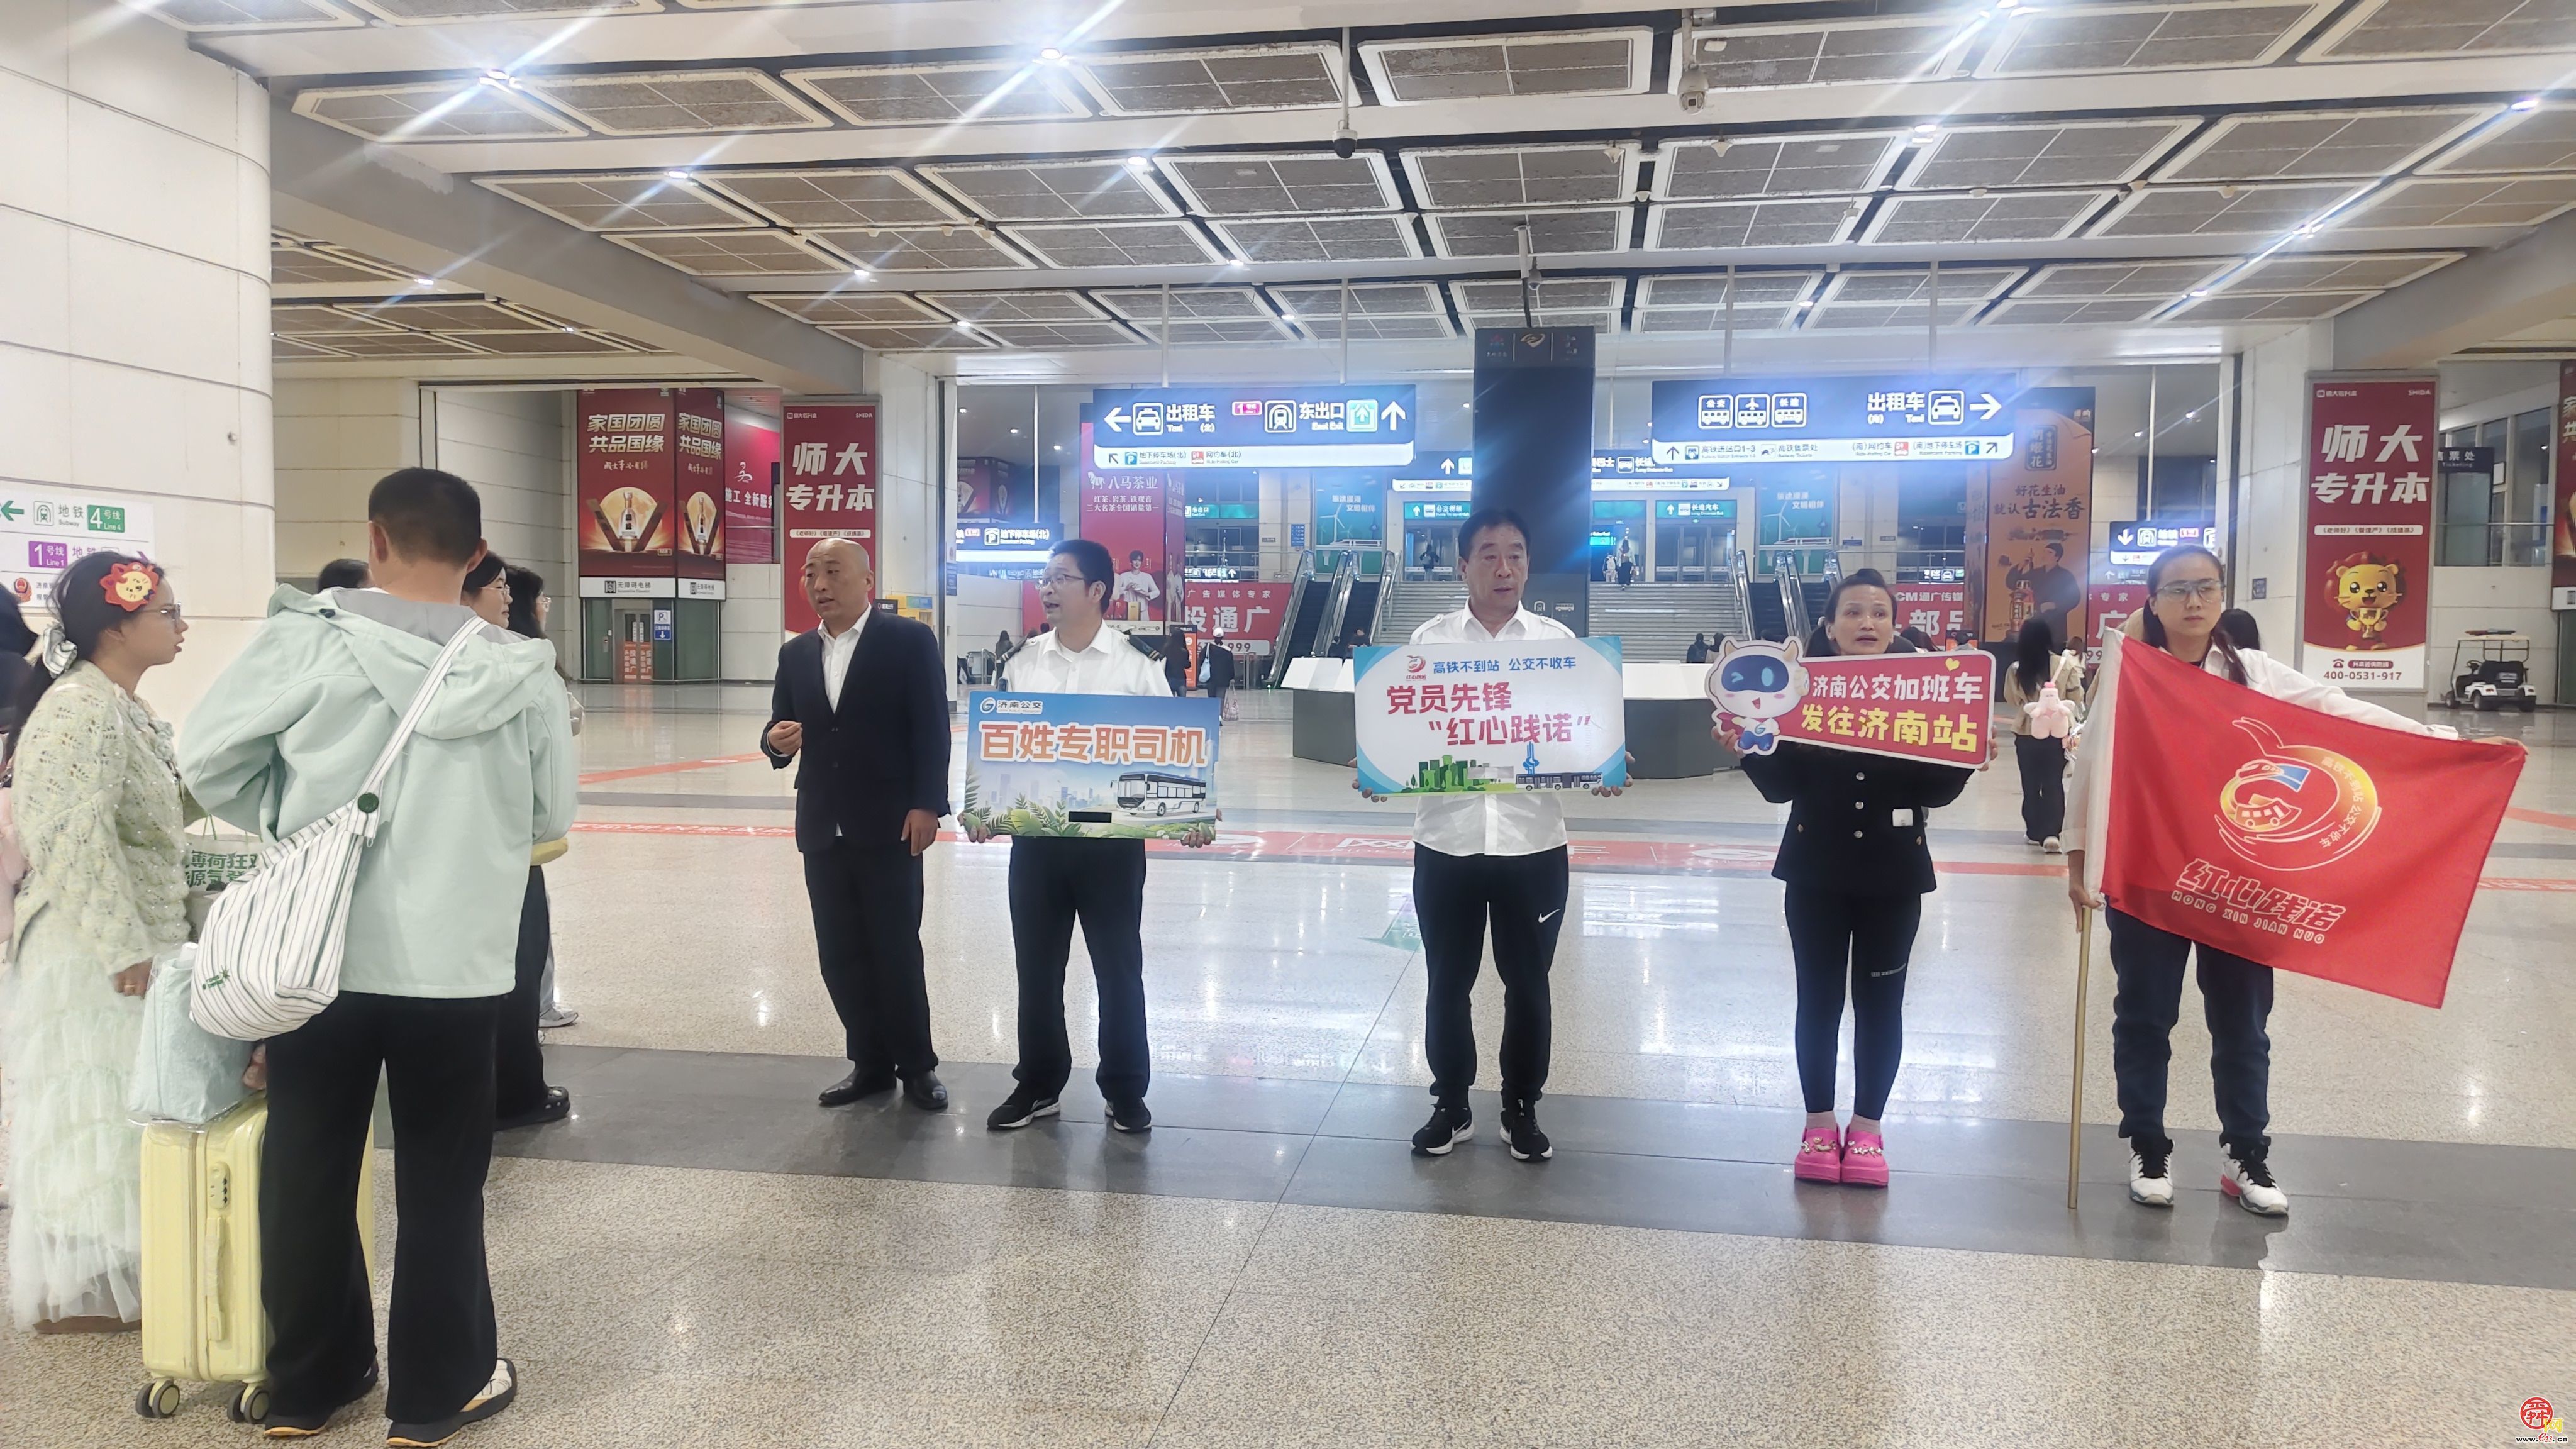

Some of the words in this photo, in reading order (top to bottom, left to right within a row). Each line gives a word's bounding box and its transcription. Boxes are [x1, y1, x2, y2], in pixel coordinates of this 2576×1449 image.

[1299, 401, 1345, 420] 东出口
[1867, 392, 1926, 412] 出租车
[1166, 403, 1216, 422] 出租车
[587, 413, 665, 433] 家国团圆
[678, 412, 722, 439] 家国团圆
[1166, 423, 1184, 433] Taxi
[589, 435, 665, 453] 共品国缘
[679, 434, 722, 460] 共品国缘
[1778, 443, 1818, 452] 高铁售票处
[2321, 424, 2423, 463] 师大
[792, 442, 868, 475] 师大
[1206, 450, 1242, 458] 网约车(北)
[1108, 475, 1158, 490] 八马茶业
[2014, 484, 2067, 497] 好花生油
[2311, 472, 2430, 504] 专升本
[786, 483, 875, 511] 专升本
[58, 504, 84, 519] 地铁
[1086, 503, 1159, 513] 三大名茶全国销量第一
[1994, 497, 2085, 520] 就认古法香
[58, 519, 80, 528] Subway
[1187, 589, 1271, 599] 广告媒体专家
[1433, 659, 1500, 674] 高铁不到站
[1509, 656, 1577, 672] 公交不收车
[2323, 670, 2402, 680] 400-0531-917
[1387, 681, 1512, 715] 党员先锋
[1812, 672, 1984, 704] 济南公交加班车
[997, 701, 1042, 709] 济南公交
[1800, 702, 1978, 753] 发往济南站
[980, 722, 1206, 765] 百姓专职司机
[2321, 757, 2364, 803] 高铁不到站
[2175, 858, 2346, 931] 红心践诺
[2171, 889, 2217, 914] HONG
[2222, 907, 2248, 925] XIN
[2253, 916, 2288, 936] JIAN
[2293, 928, 2326, 945] NUO
